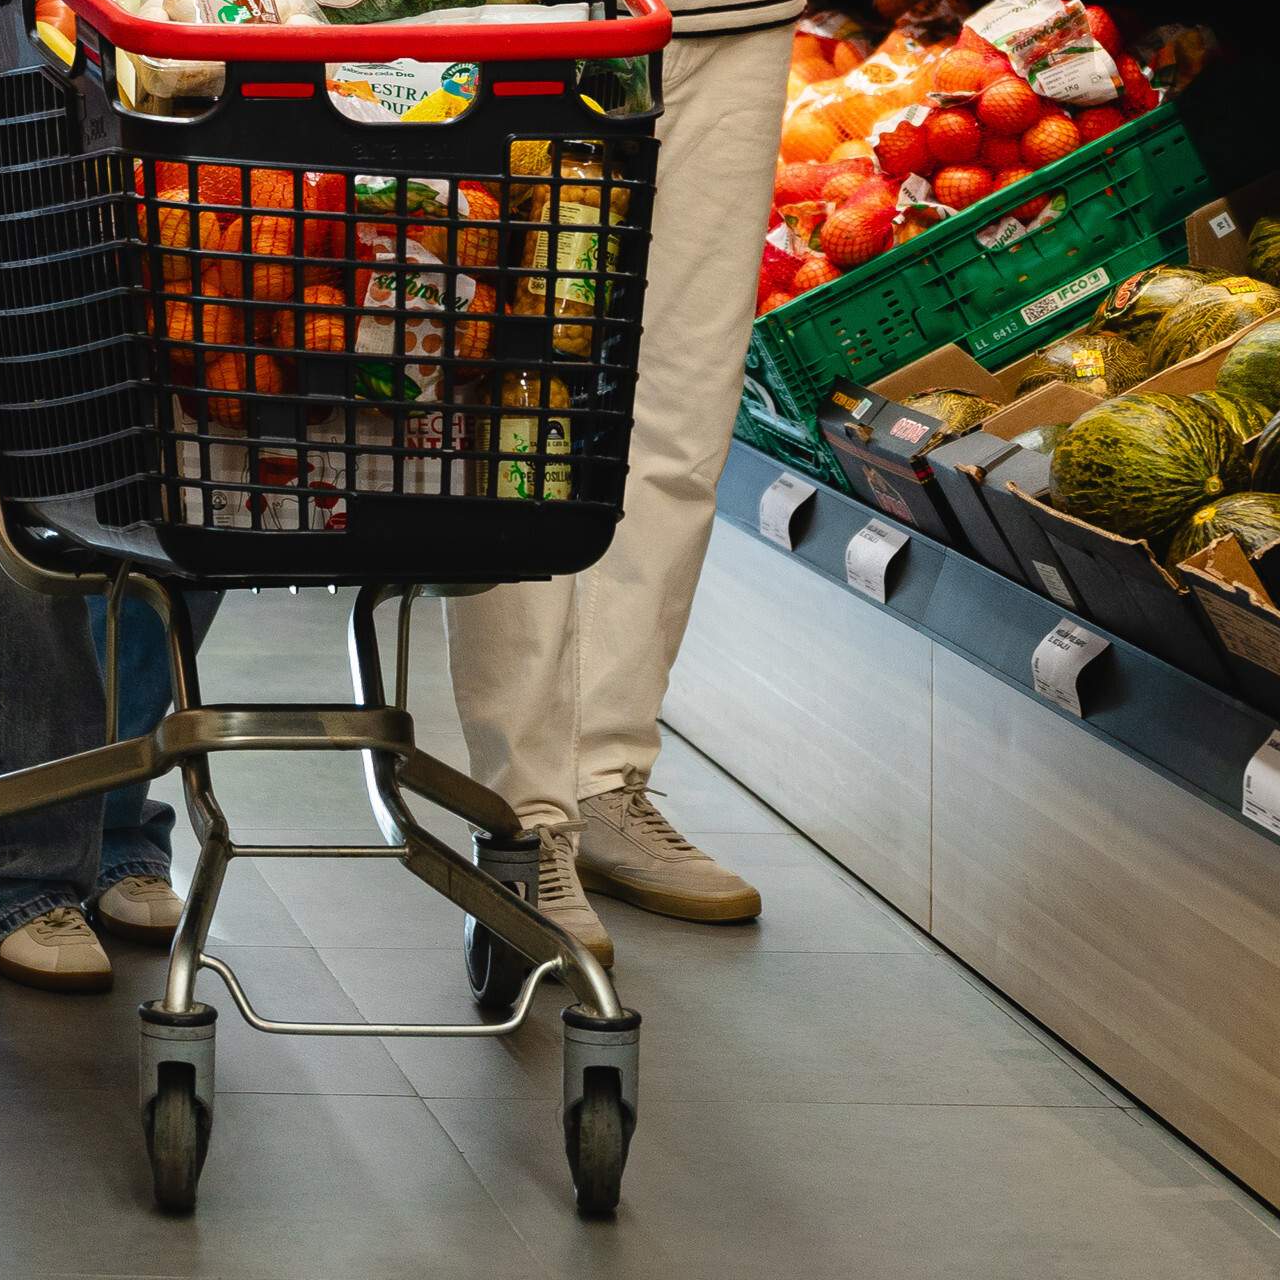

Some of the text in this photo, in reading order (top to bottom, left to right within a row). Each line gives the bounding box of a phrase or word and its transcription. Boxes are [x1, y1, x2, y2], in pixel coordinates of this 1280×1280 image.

[1057, 279, 1088, 302] IFCO
[974, 322, 1019, 351] LL 6413
